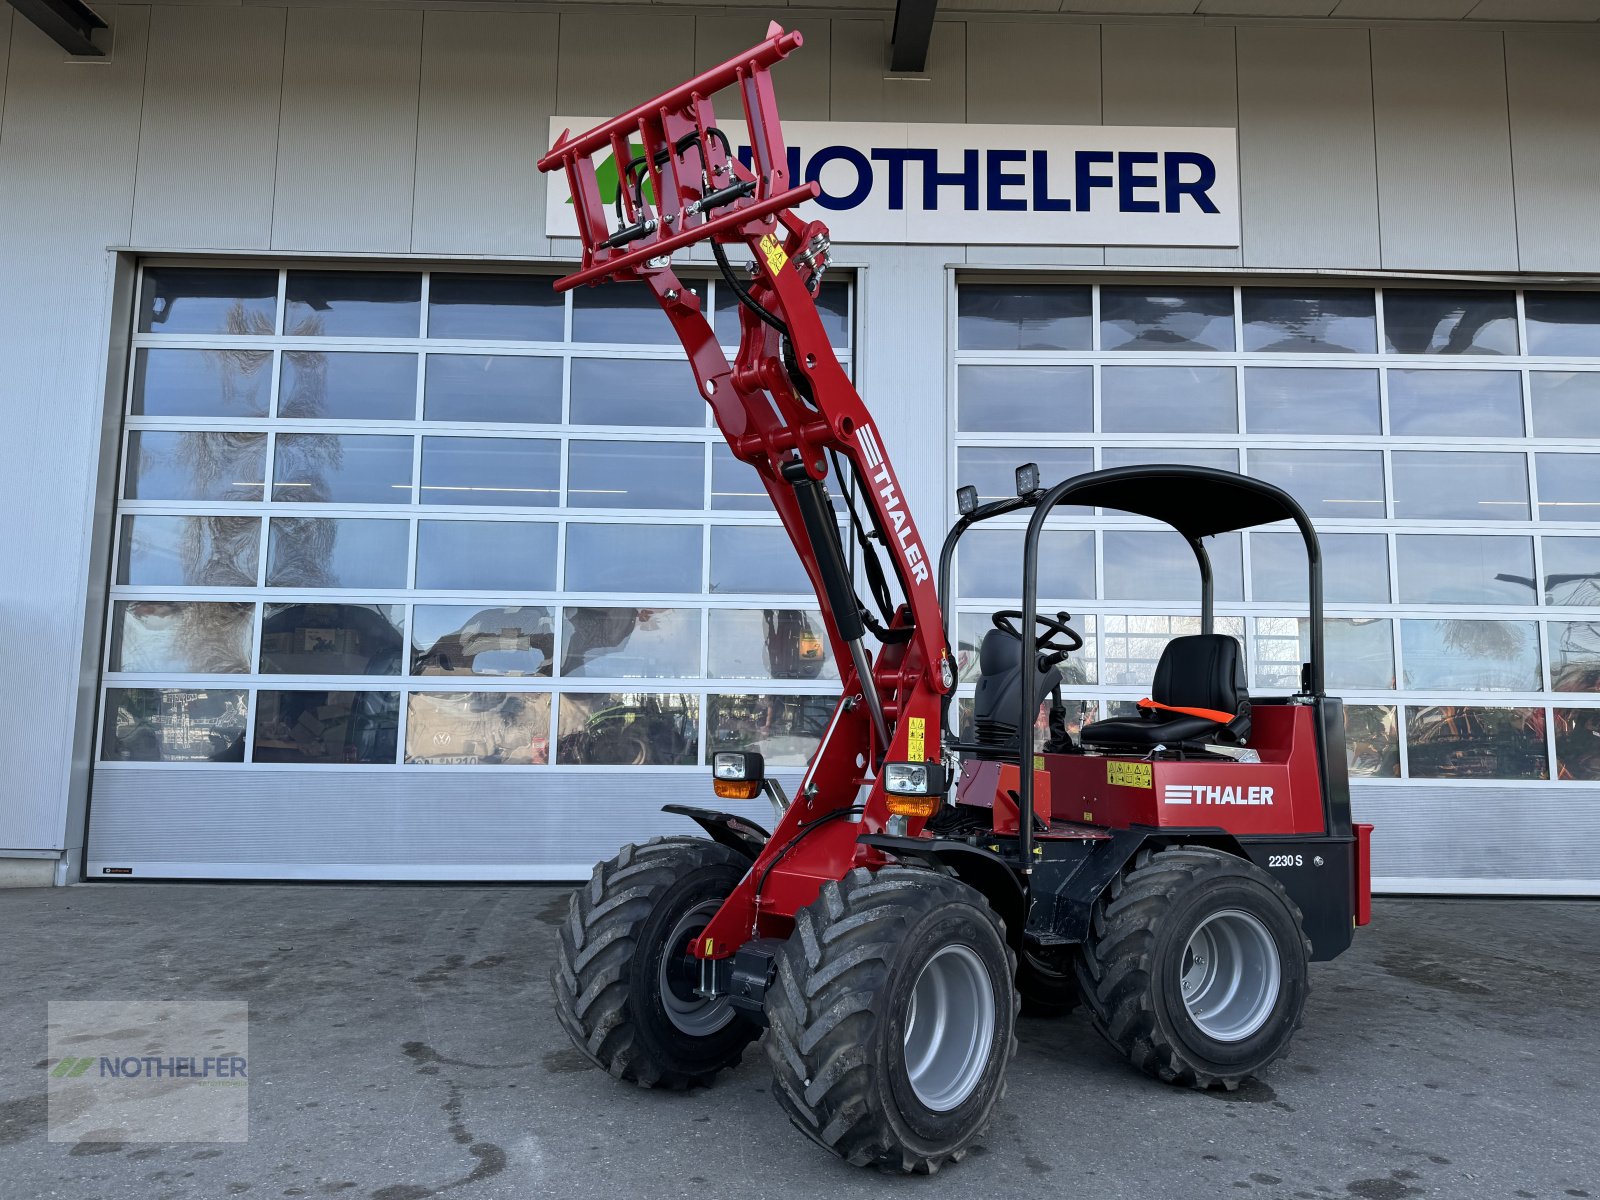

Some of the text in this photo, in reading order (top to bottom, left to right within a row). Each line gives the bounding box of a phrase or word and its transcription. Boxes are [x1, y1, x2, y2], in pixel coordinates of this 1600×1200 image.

[873, 462, 929, 586] THALER
[1192, 785, 1274, 805] THALER
[1268, 854, 1303, 867] 2230 S
